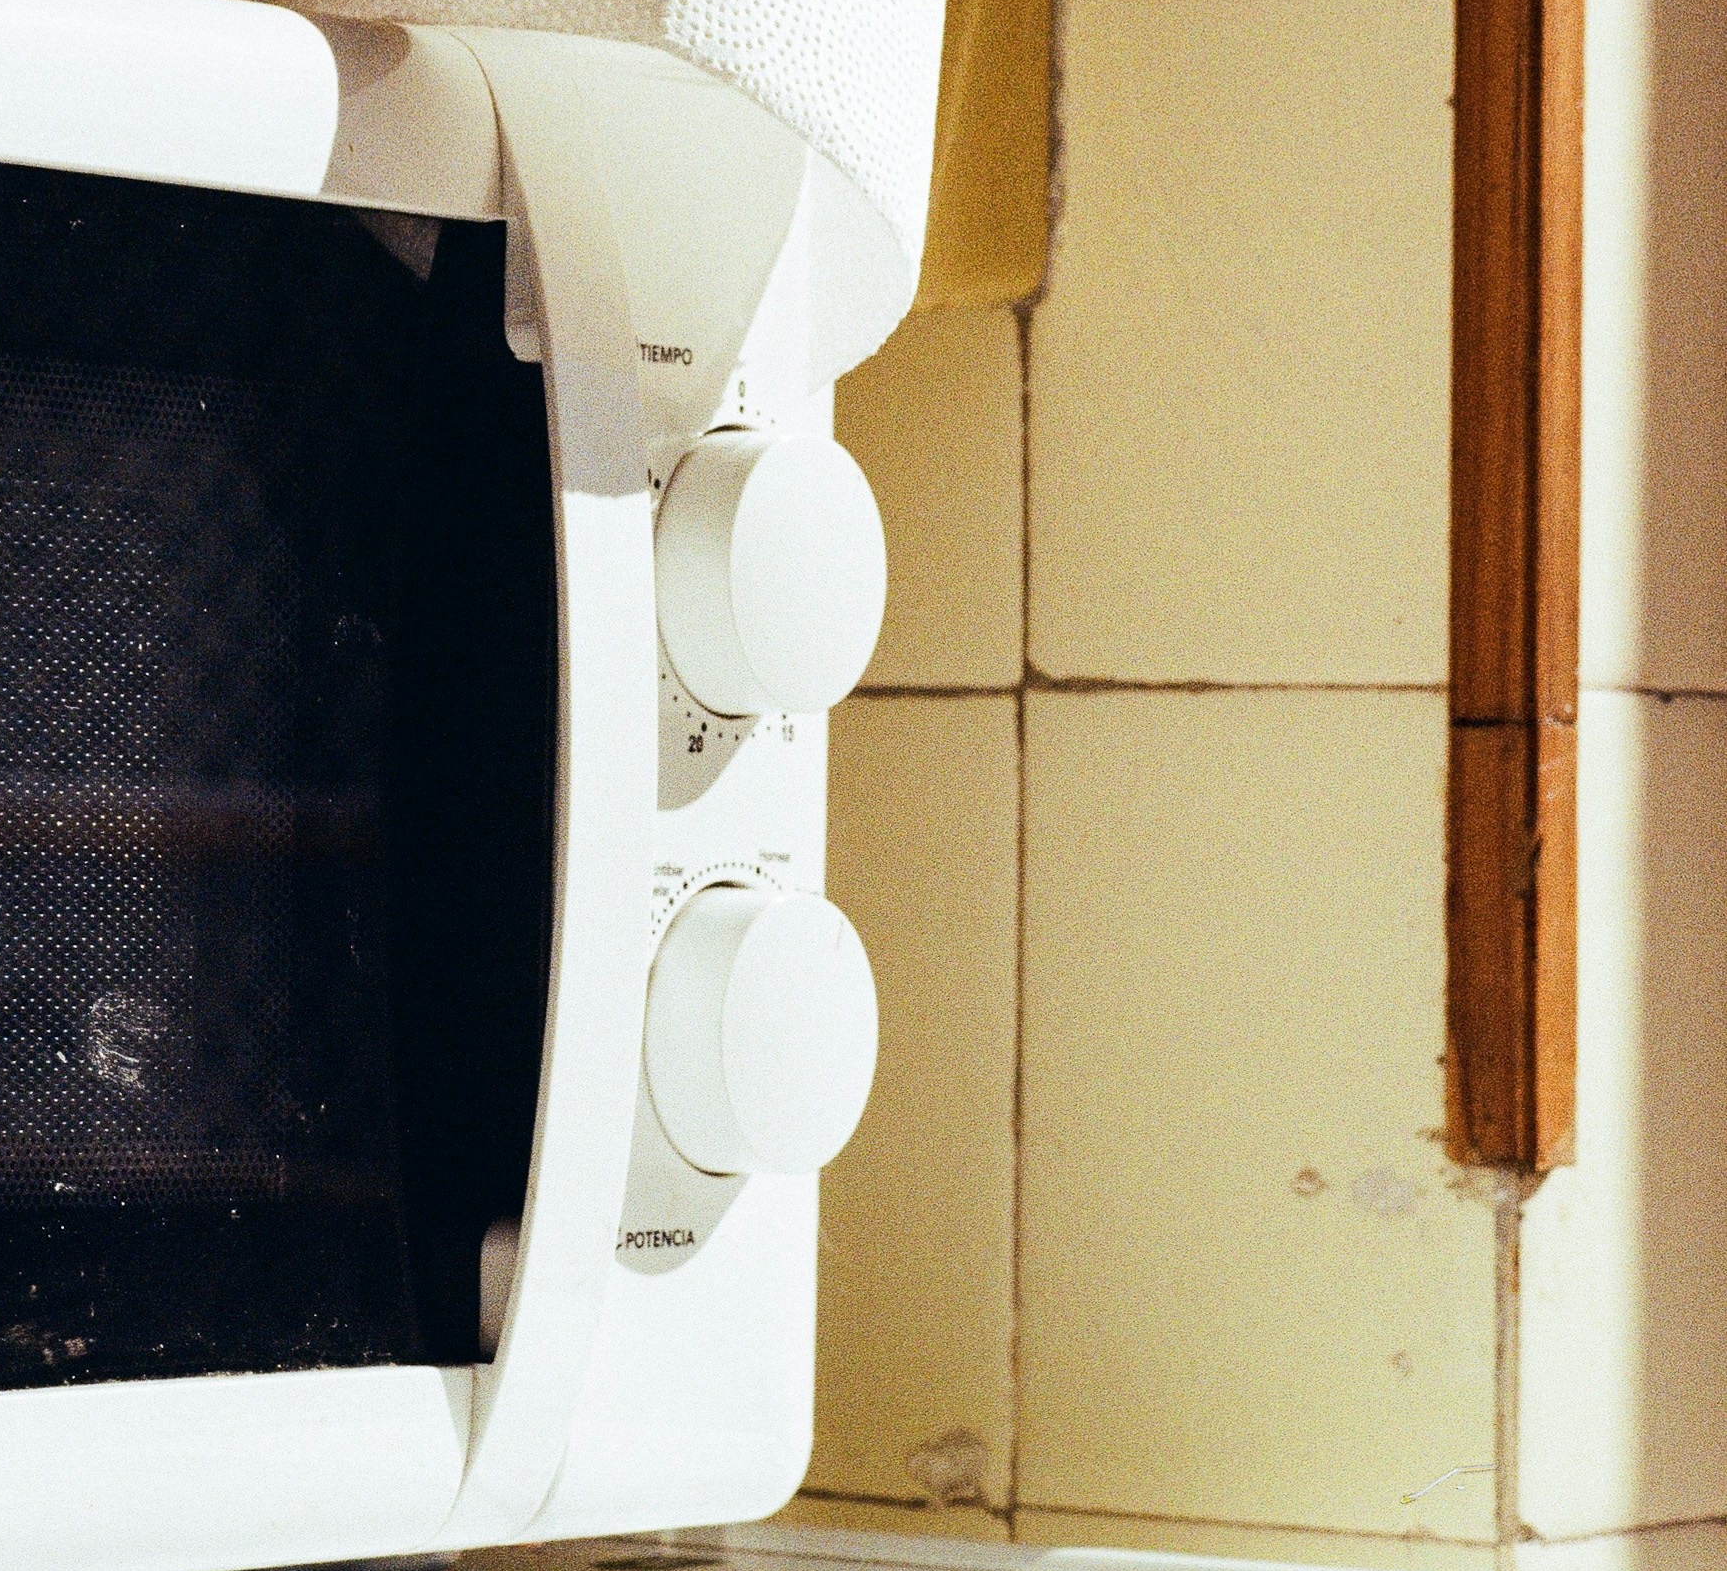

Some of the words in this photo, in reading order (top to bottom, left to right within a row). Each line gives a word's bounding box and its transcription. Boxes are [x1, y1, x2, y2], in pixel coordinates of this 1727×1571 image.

[641, 343, 692, 366] TIEMPO
[689, 734, 703, 753] 20
[626, 1228, 694, 1249] POTENCIA
